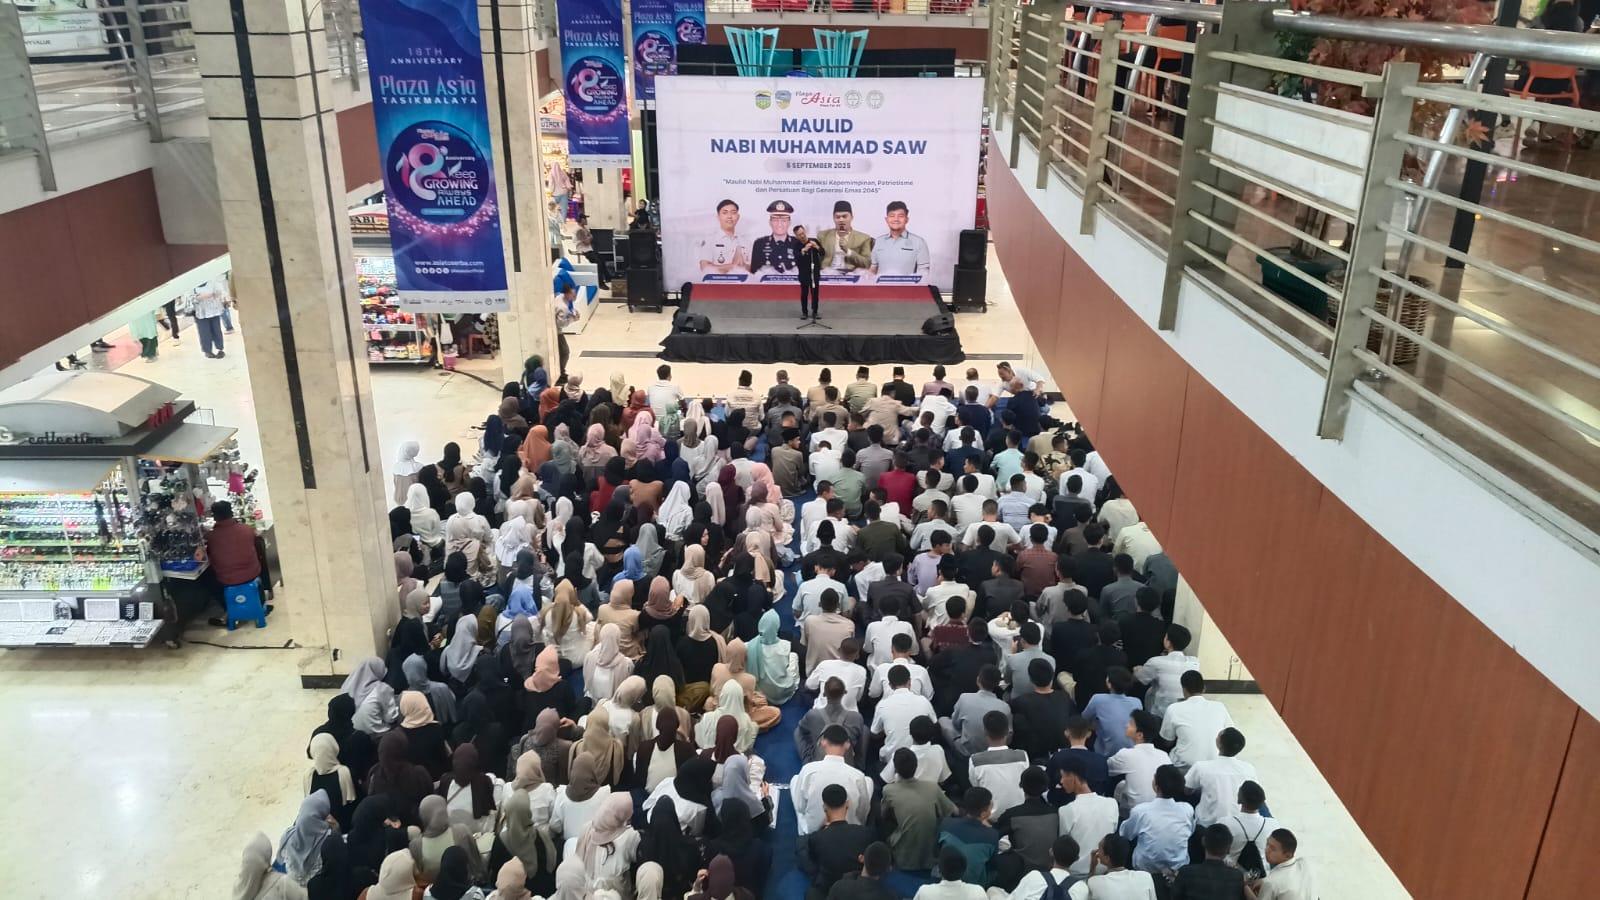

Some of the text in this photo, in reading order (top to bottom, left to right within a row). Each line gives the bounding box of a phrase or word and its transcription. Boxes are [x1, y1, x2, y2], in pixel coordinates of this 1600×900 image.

[564, 30, 620, 41] Plaza Asia
[407, 48, 443, 56] 18TH
[379, 75, 476, 95] Plaza Asia
[801, 92, 840, 104] Asia
[781, 118, 853, 132] MAULID
[710, 138, 928, 154] NABI MUHAMMAD SAW
[424, 180, 478, 190] GROWING
[437, 196, 477, 206] AHEAD
